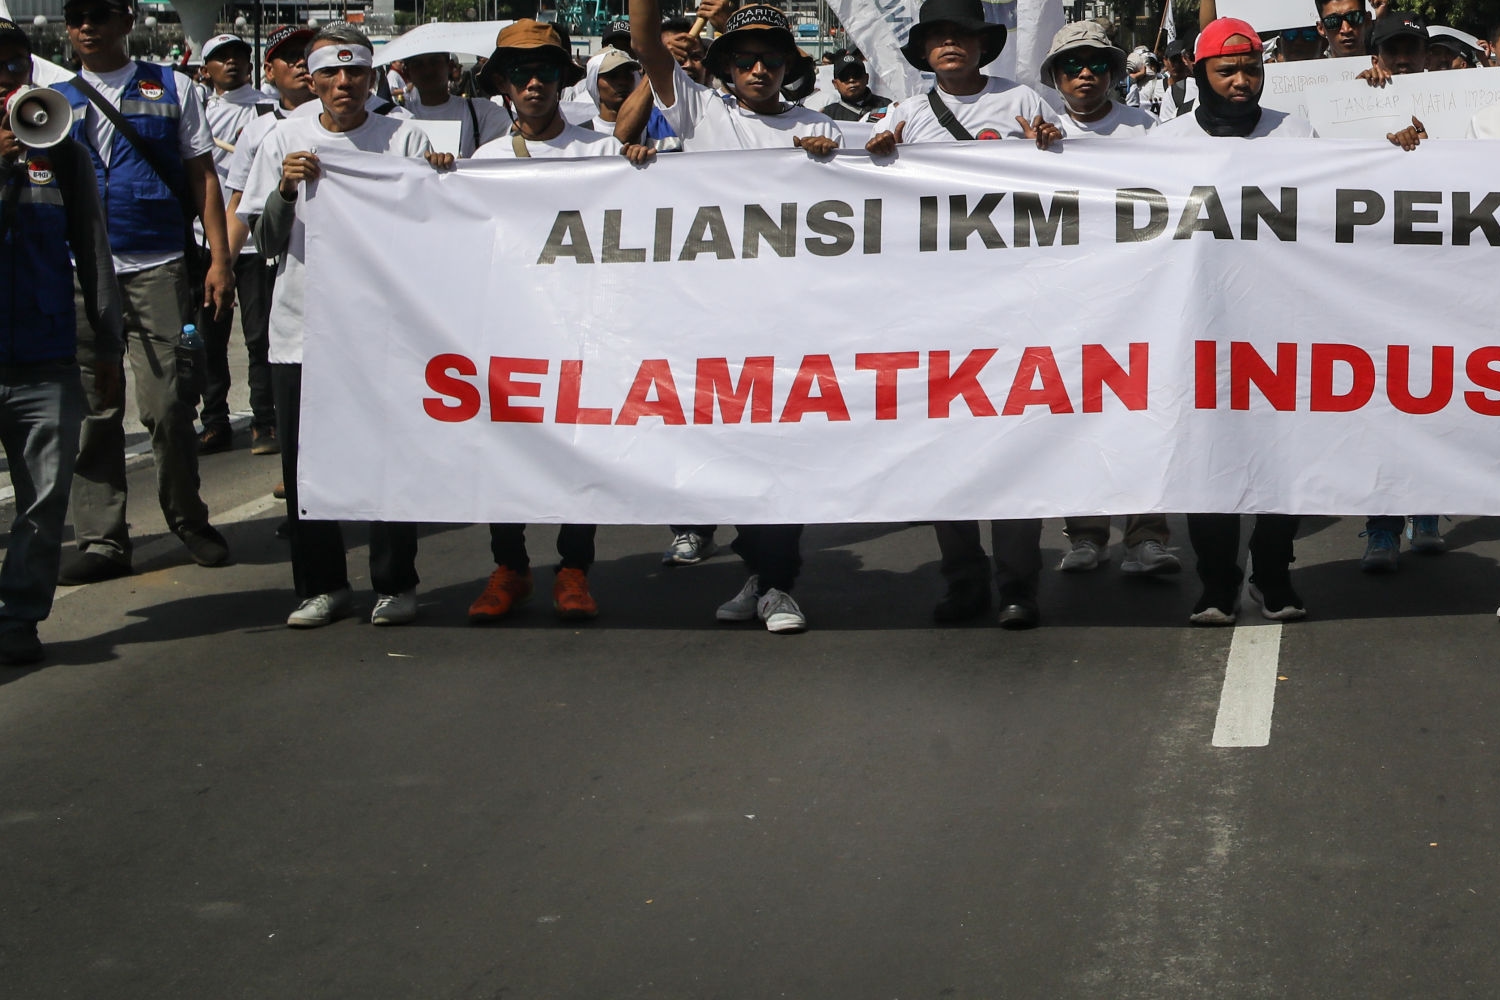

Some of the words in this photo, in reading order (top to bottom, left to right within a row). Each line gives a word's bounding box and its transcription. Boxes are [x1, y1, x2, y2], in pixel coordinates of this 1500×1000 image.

[1411, 91, 1457, 117] MAFIA
[537, 198, 884, 265] ALIANSI
[919, 191, 1081, 253] IKM
[1114, 185, 1298, 243] DAN
[422, 342, 1150, 426] SELAMATKAN
